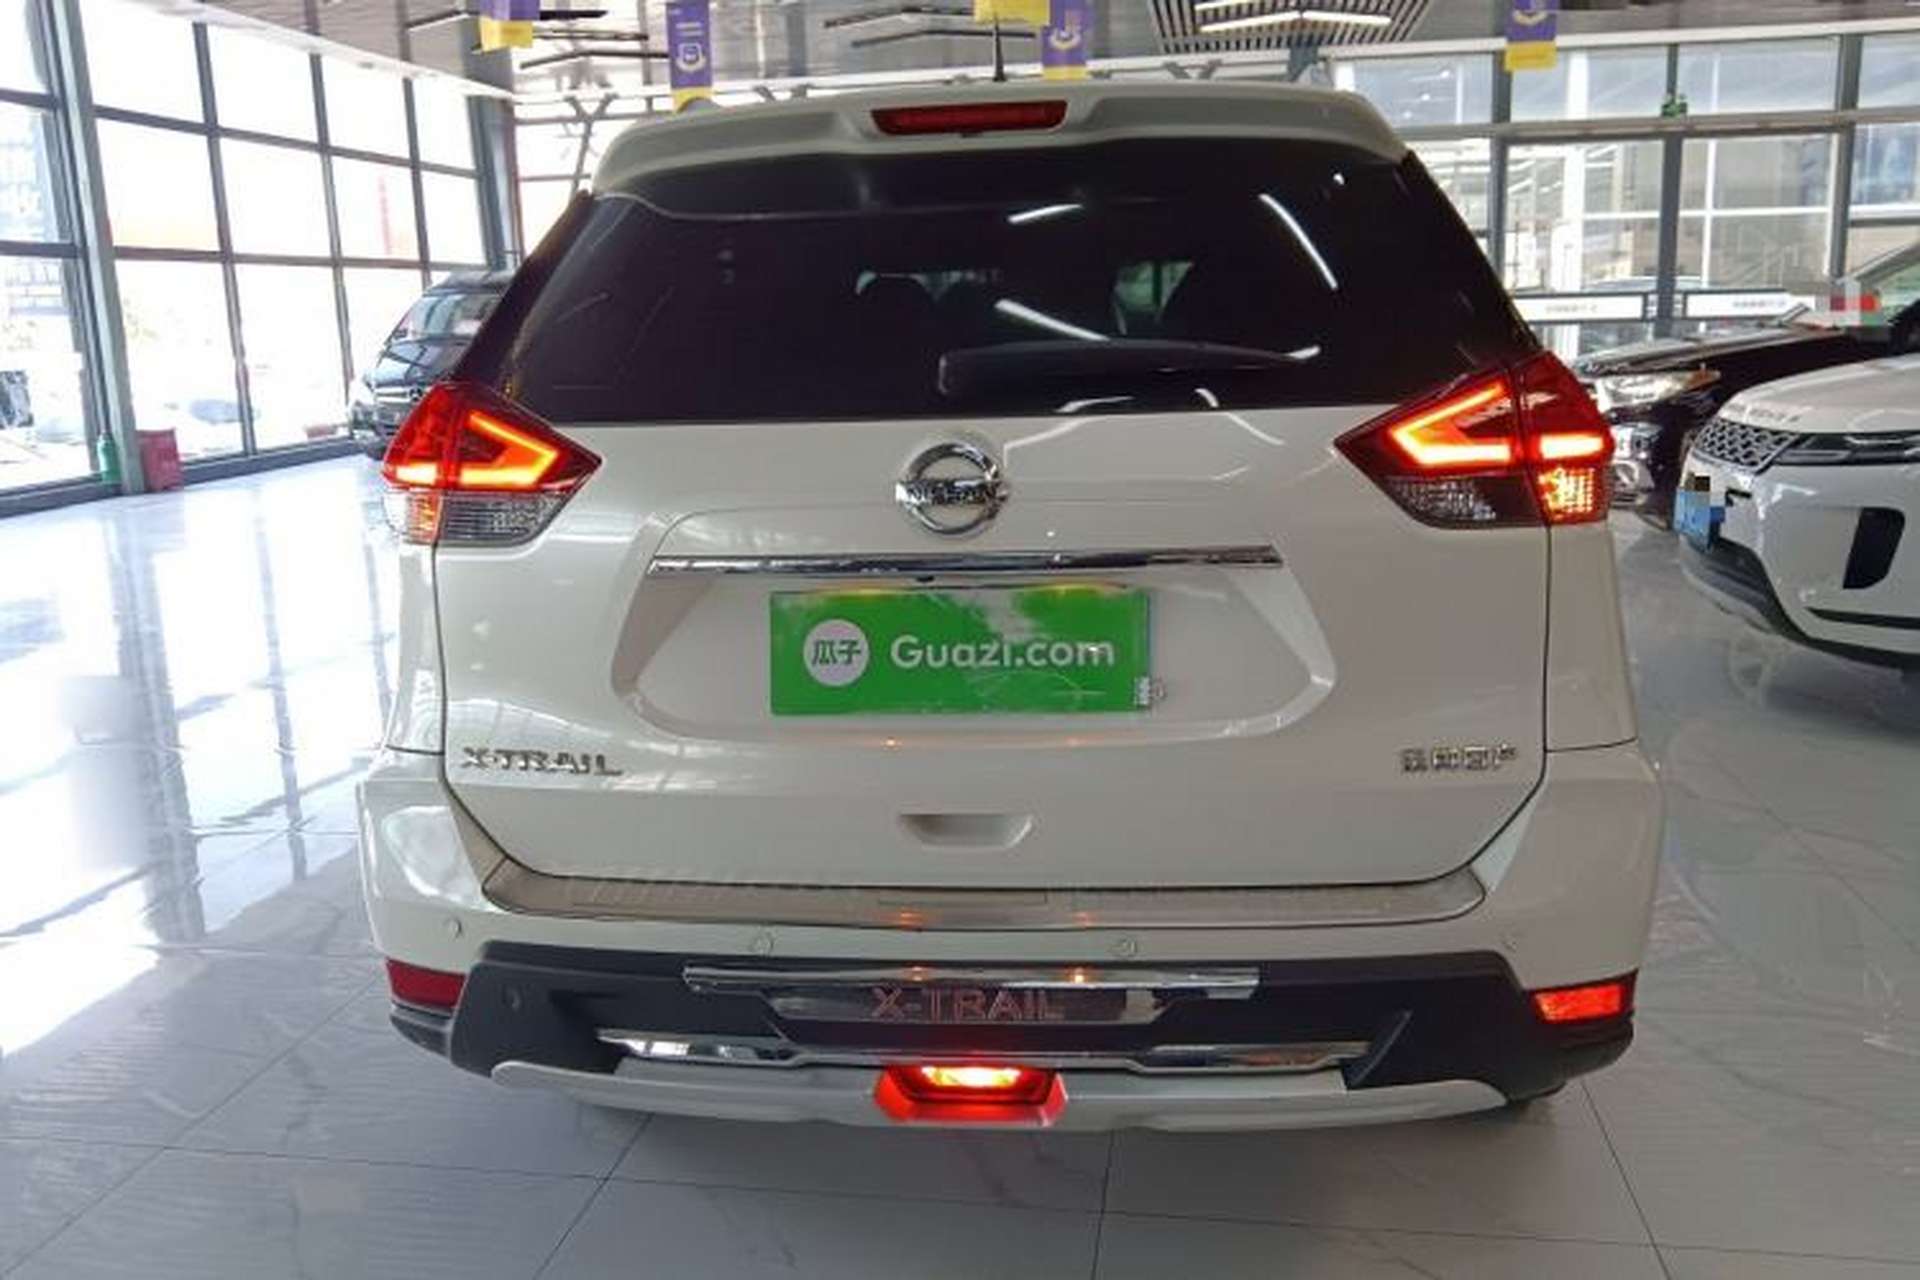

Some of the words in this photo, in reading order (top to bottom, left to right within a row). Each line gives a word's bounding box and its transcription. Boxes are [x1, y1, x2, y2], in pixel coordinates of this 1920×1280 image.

[811, 639, 862, 667] 瓜子
[891, 634, 1115, 669] Guazi.com
[461, 747, 624, 777] X-TRAIL
[871, 985, 1068, 1023] X-TRAIL
